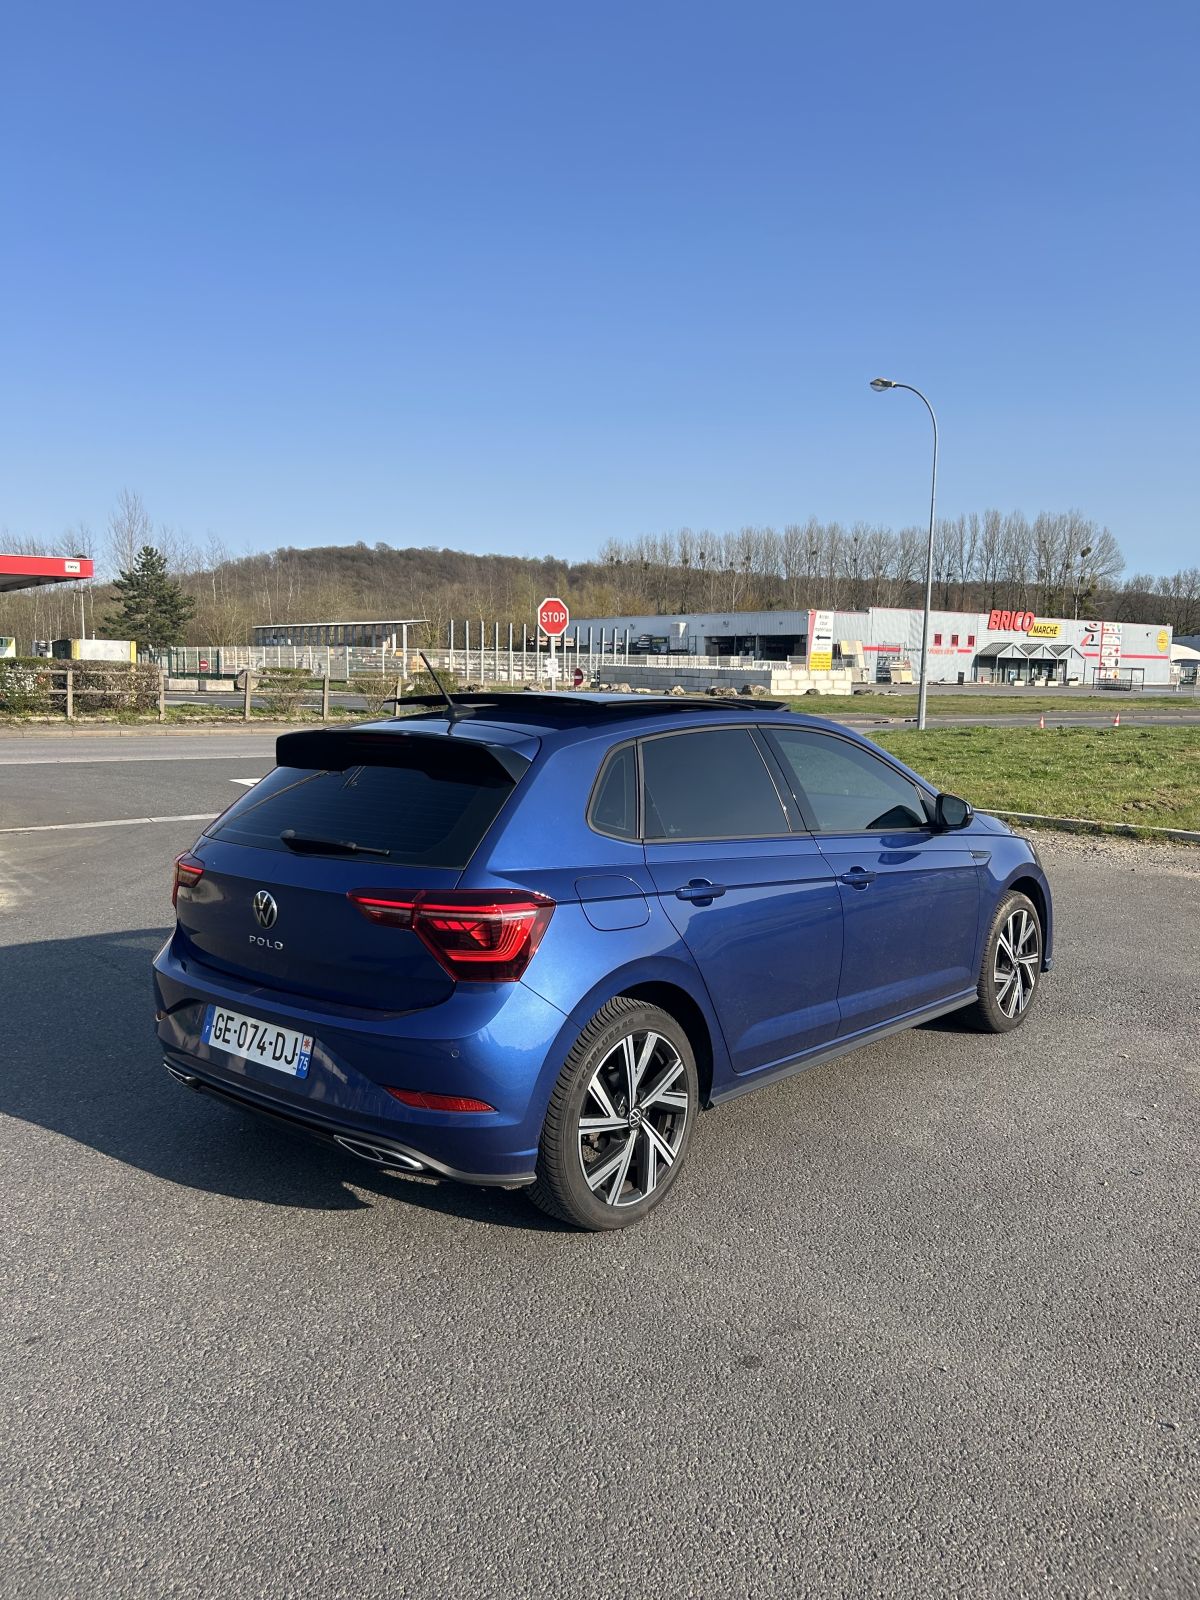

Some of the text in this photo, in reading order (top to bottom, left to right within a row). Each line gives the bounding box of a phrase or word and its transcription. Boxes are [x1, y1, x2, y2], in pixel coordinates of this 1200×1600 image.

[541, 612, 565, 623] STOP
[988, 609, 1035, 631] BRICO
[249, 935, 283, 950] POLO
[213, 1013, 299, 1065] GE-074-DJ
[299, 1055, 309, 1071] 75
